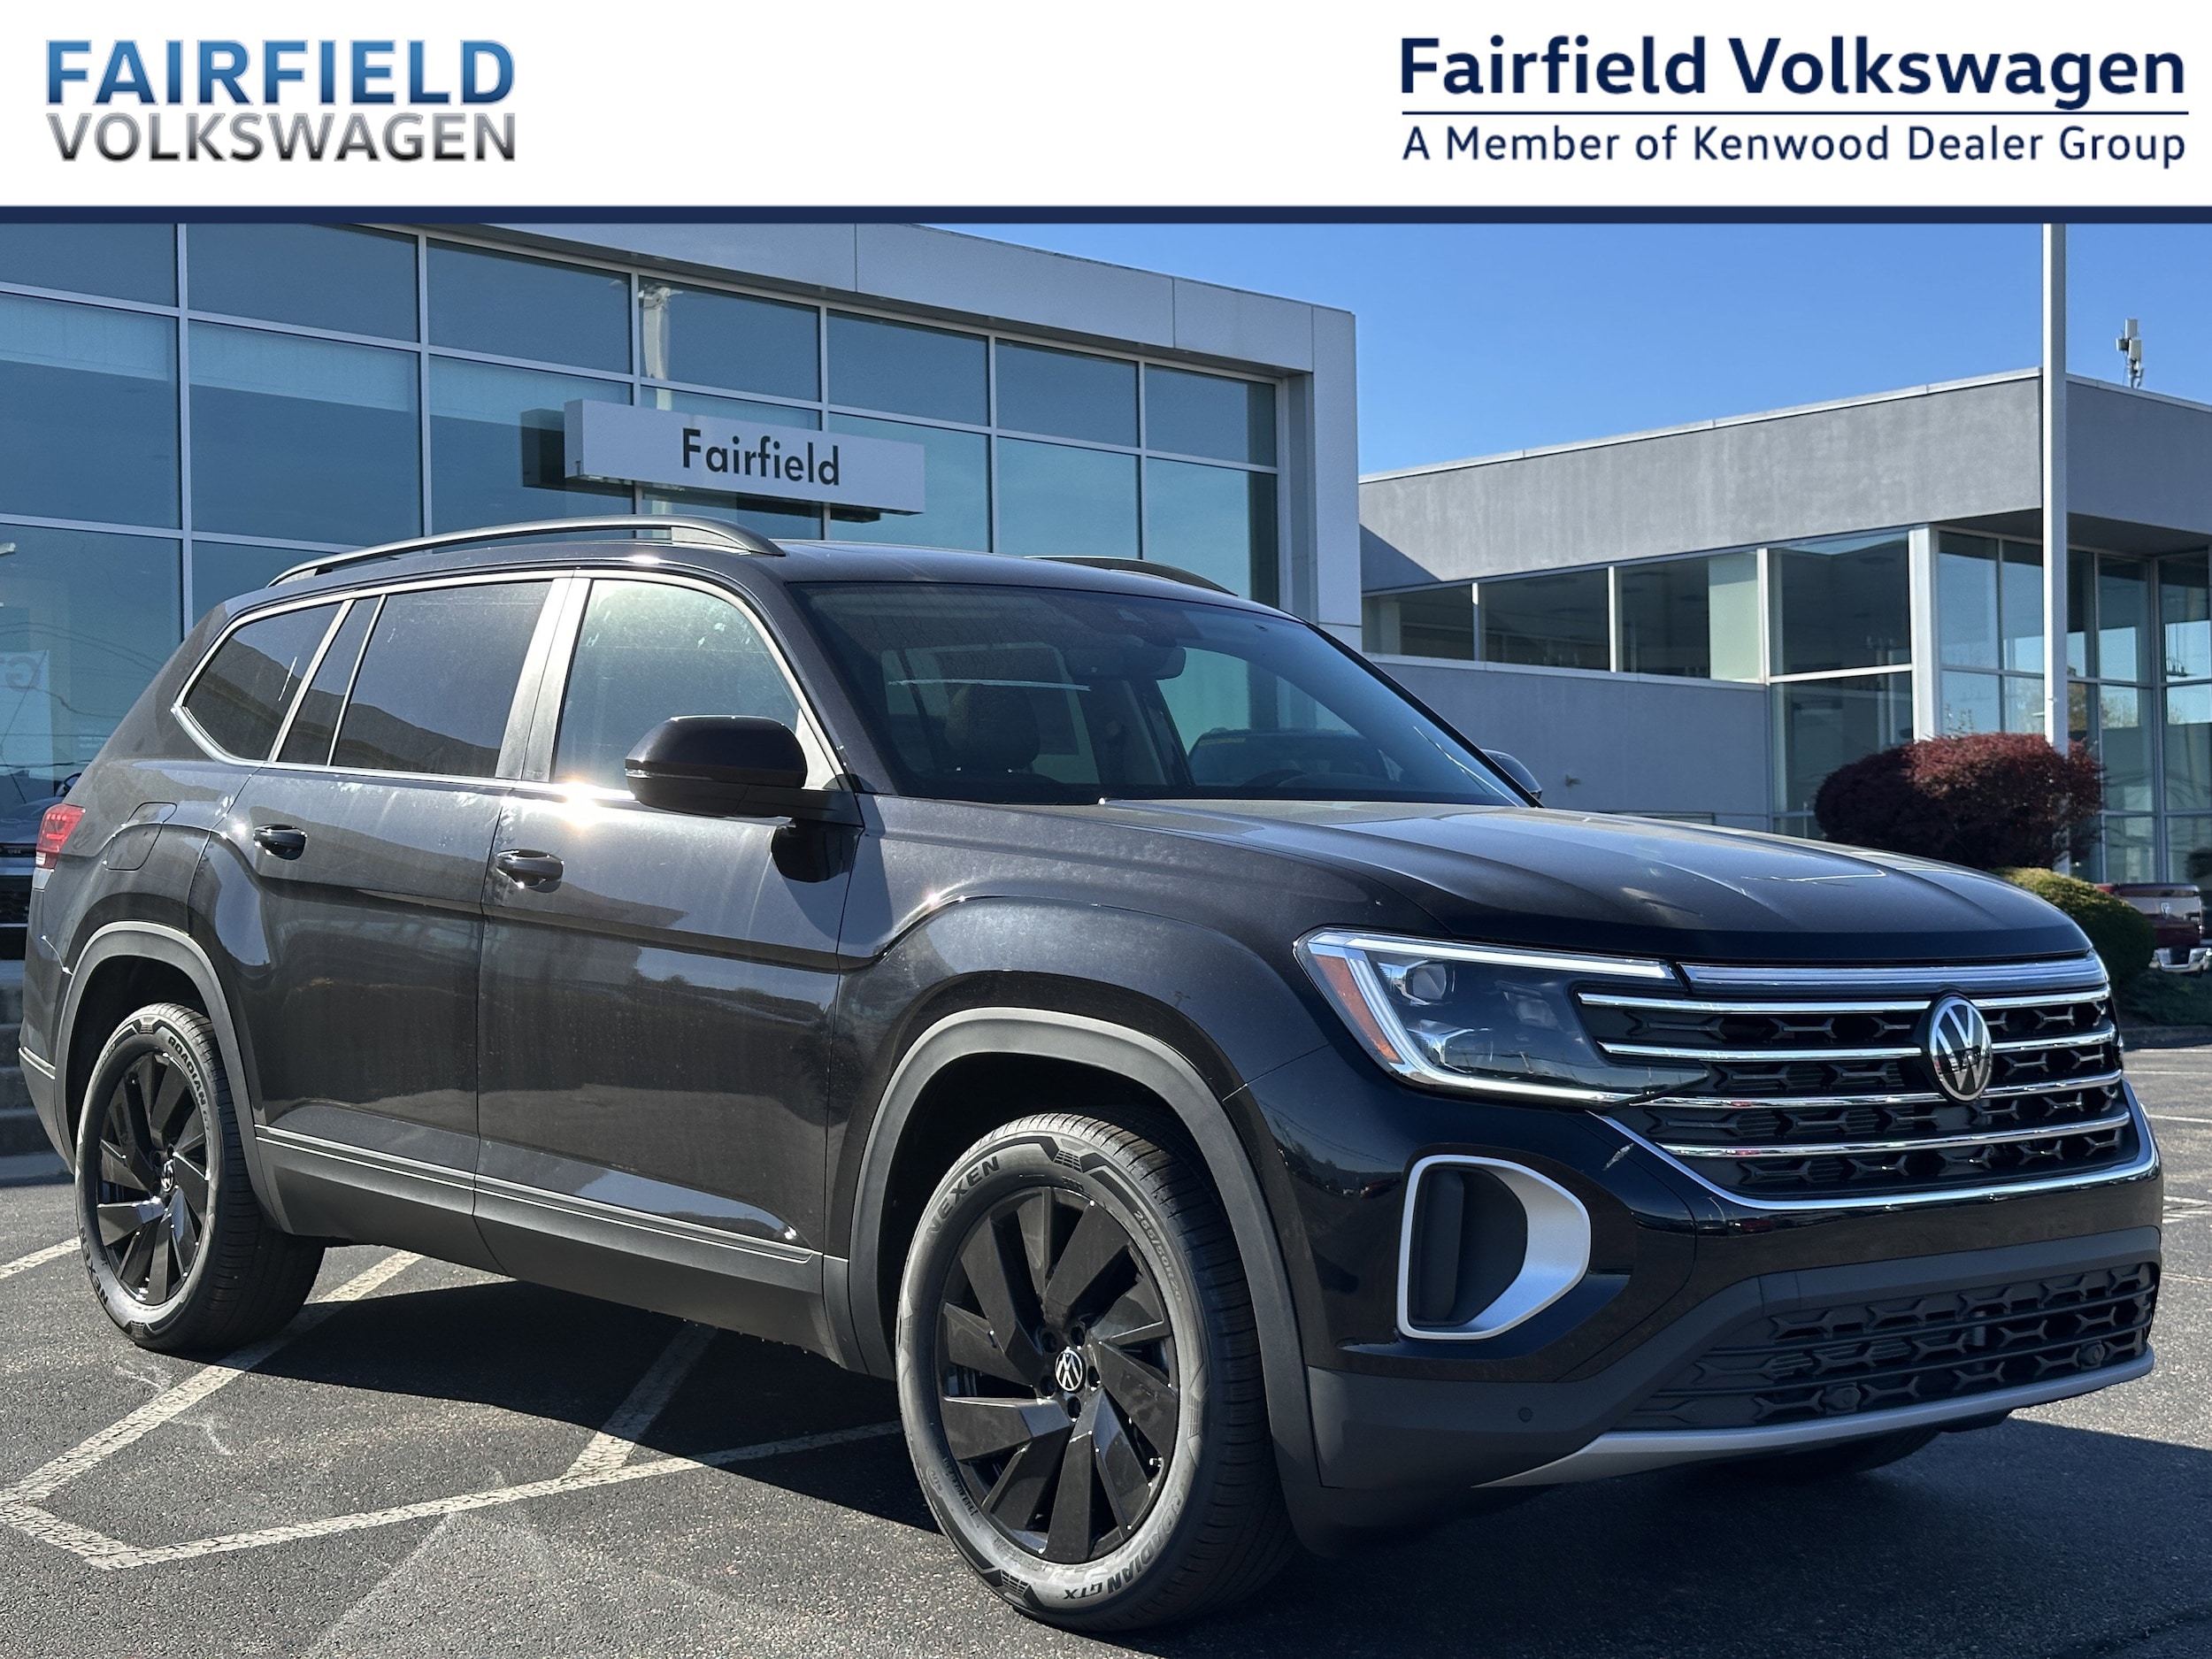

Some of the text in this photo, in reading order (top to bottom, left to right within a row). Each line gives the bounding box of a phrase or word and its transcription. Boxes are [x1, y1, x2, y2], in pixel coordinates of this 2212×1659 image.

[682, 427, 840, 486] Fairfield
[167, 1036, 207, 1106] ROADIAN
[926, 1156, 1000, 1235] NEXEN
[80, 1226, 109, 1305] NEXEN
[1063, 1582, 1103, 1600] GTX
